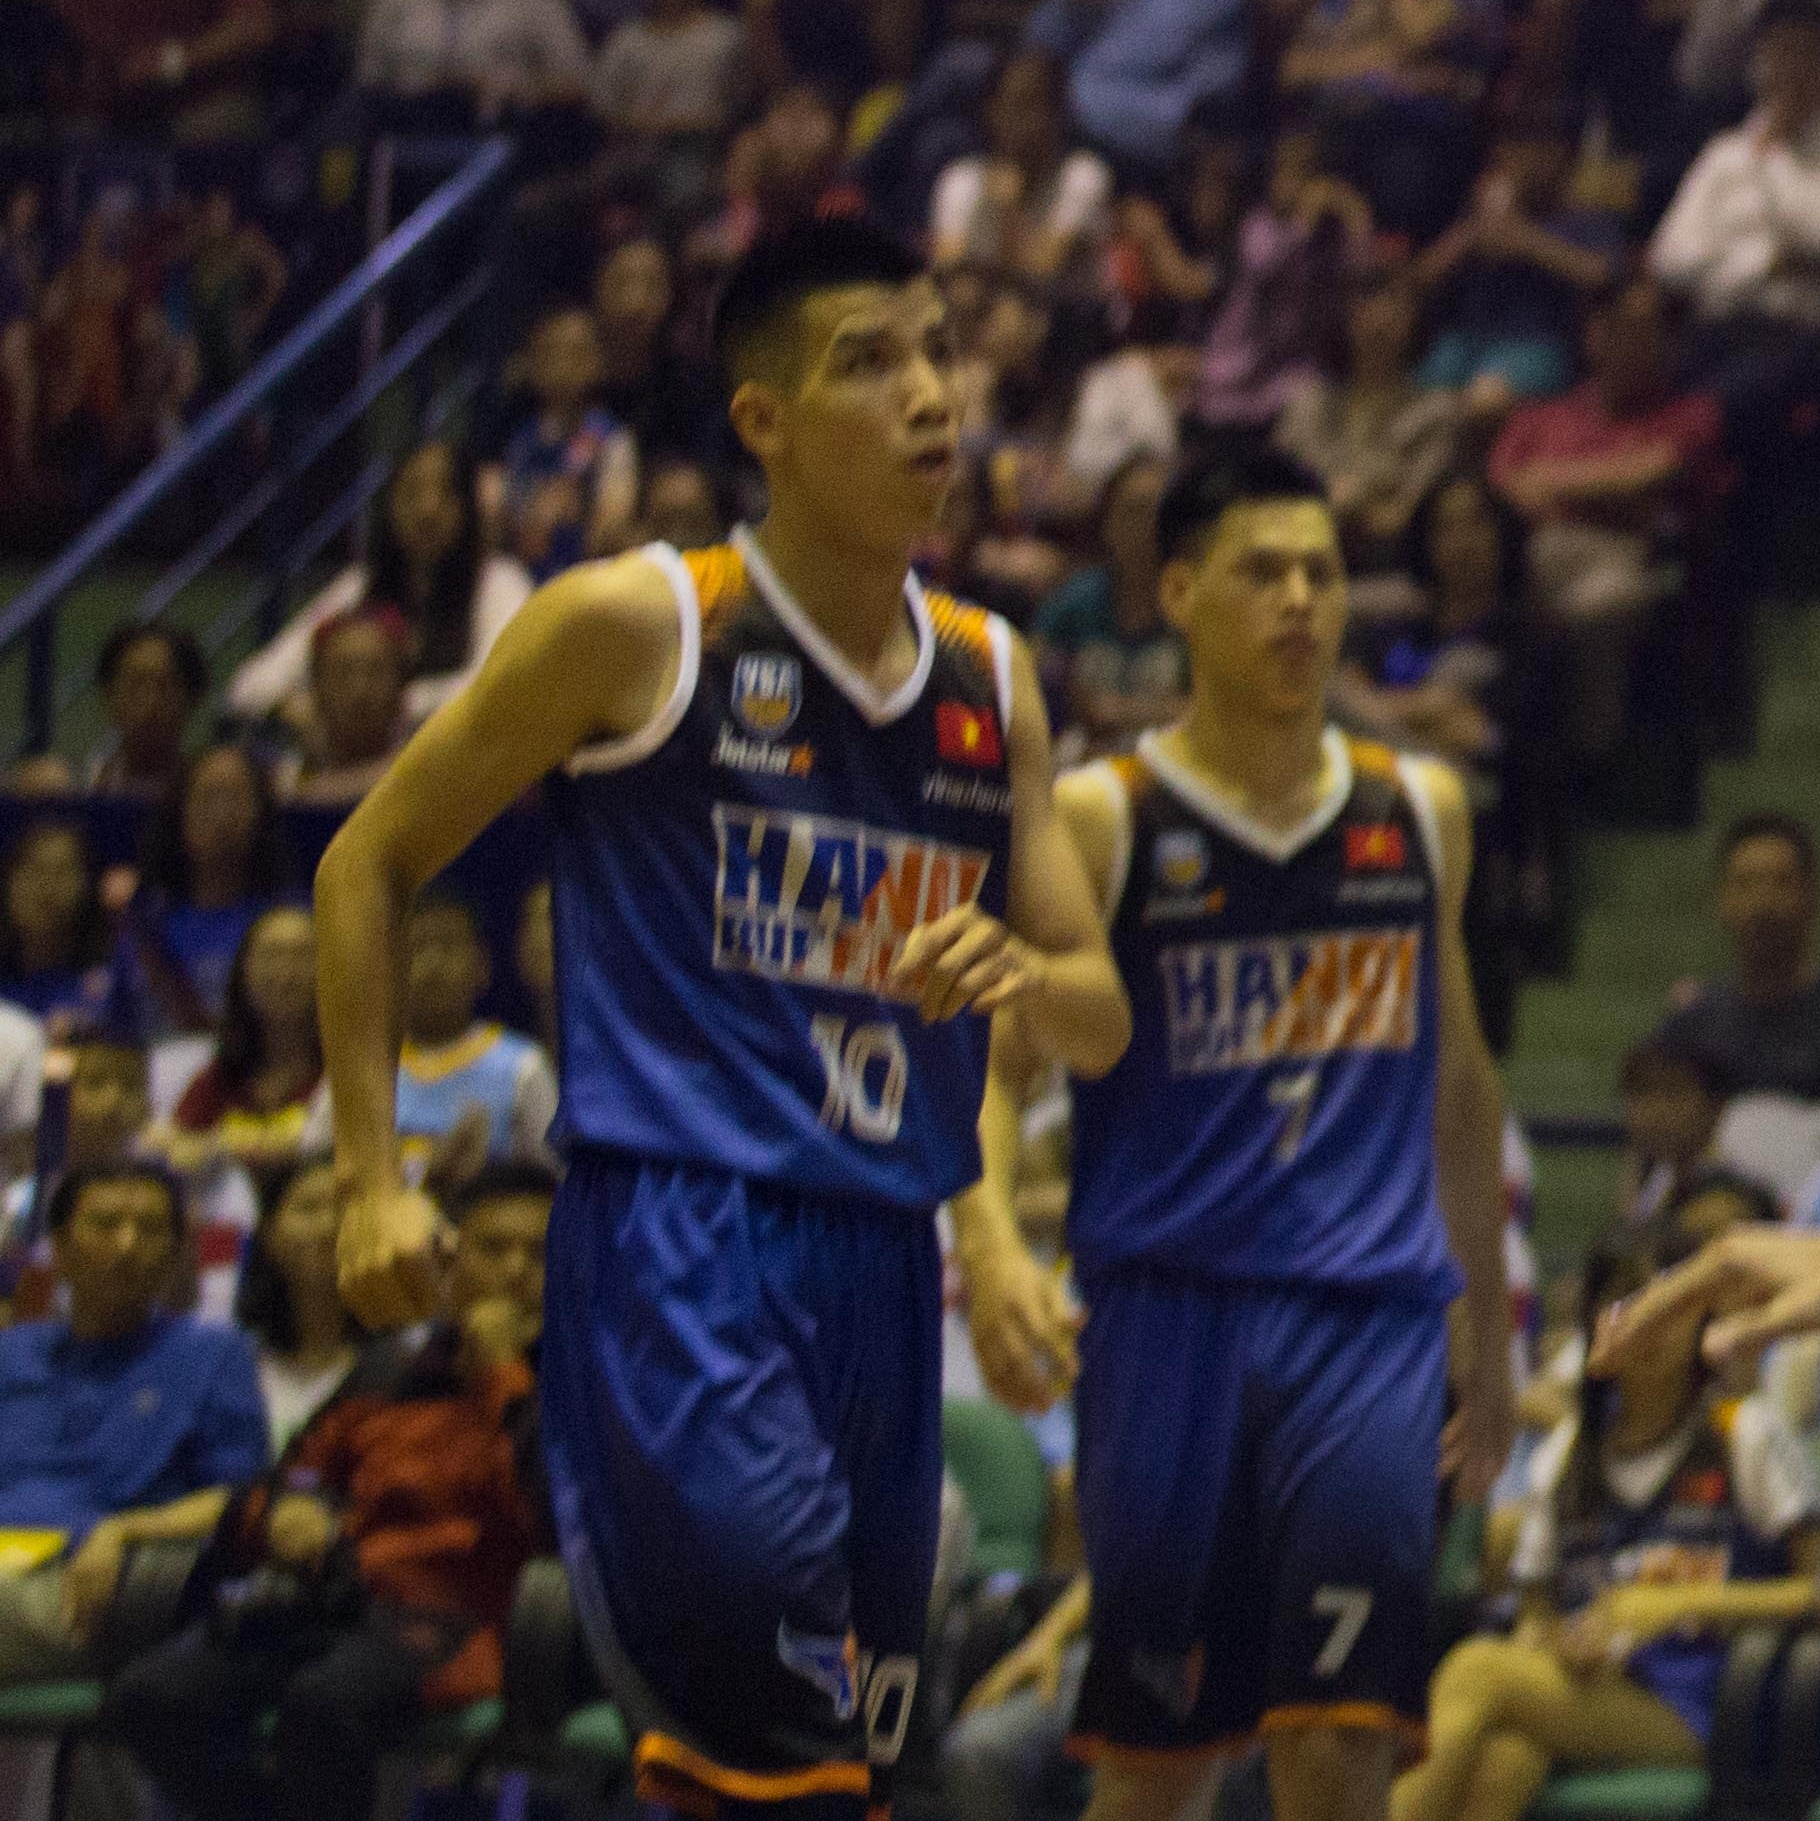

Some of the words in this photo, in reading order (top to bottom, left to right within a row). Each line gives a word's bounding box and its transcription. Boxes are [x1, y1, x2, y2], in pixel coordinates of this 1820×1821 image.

[810, 1012, 908, 1144] 10
[1266, 1070, 1320, 1164] 7
[1312, 1584, 1374, 1678] 7
